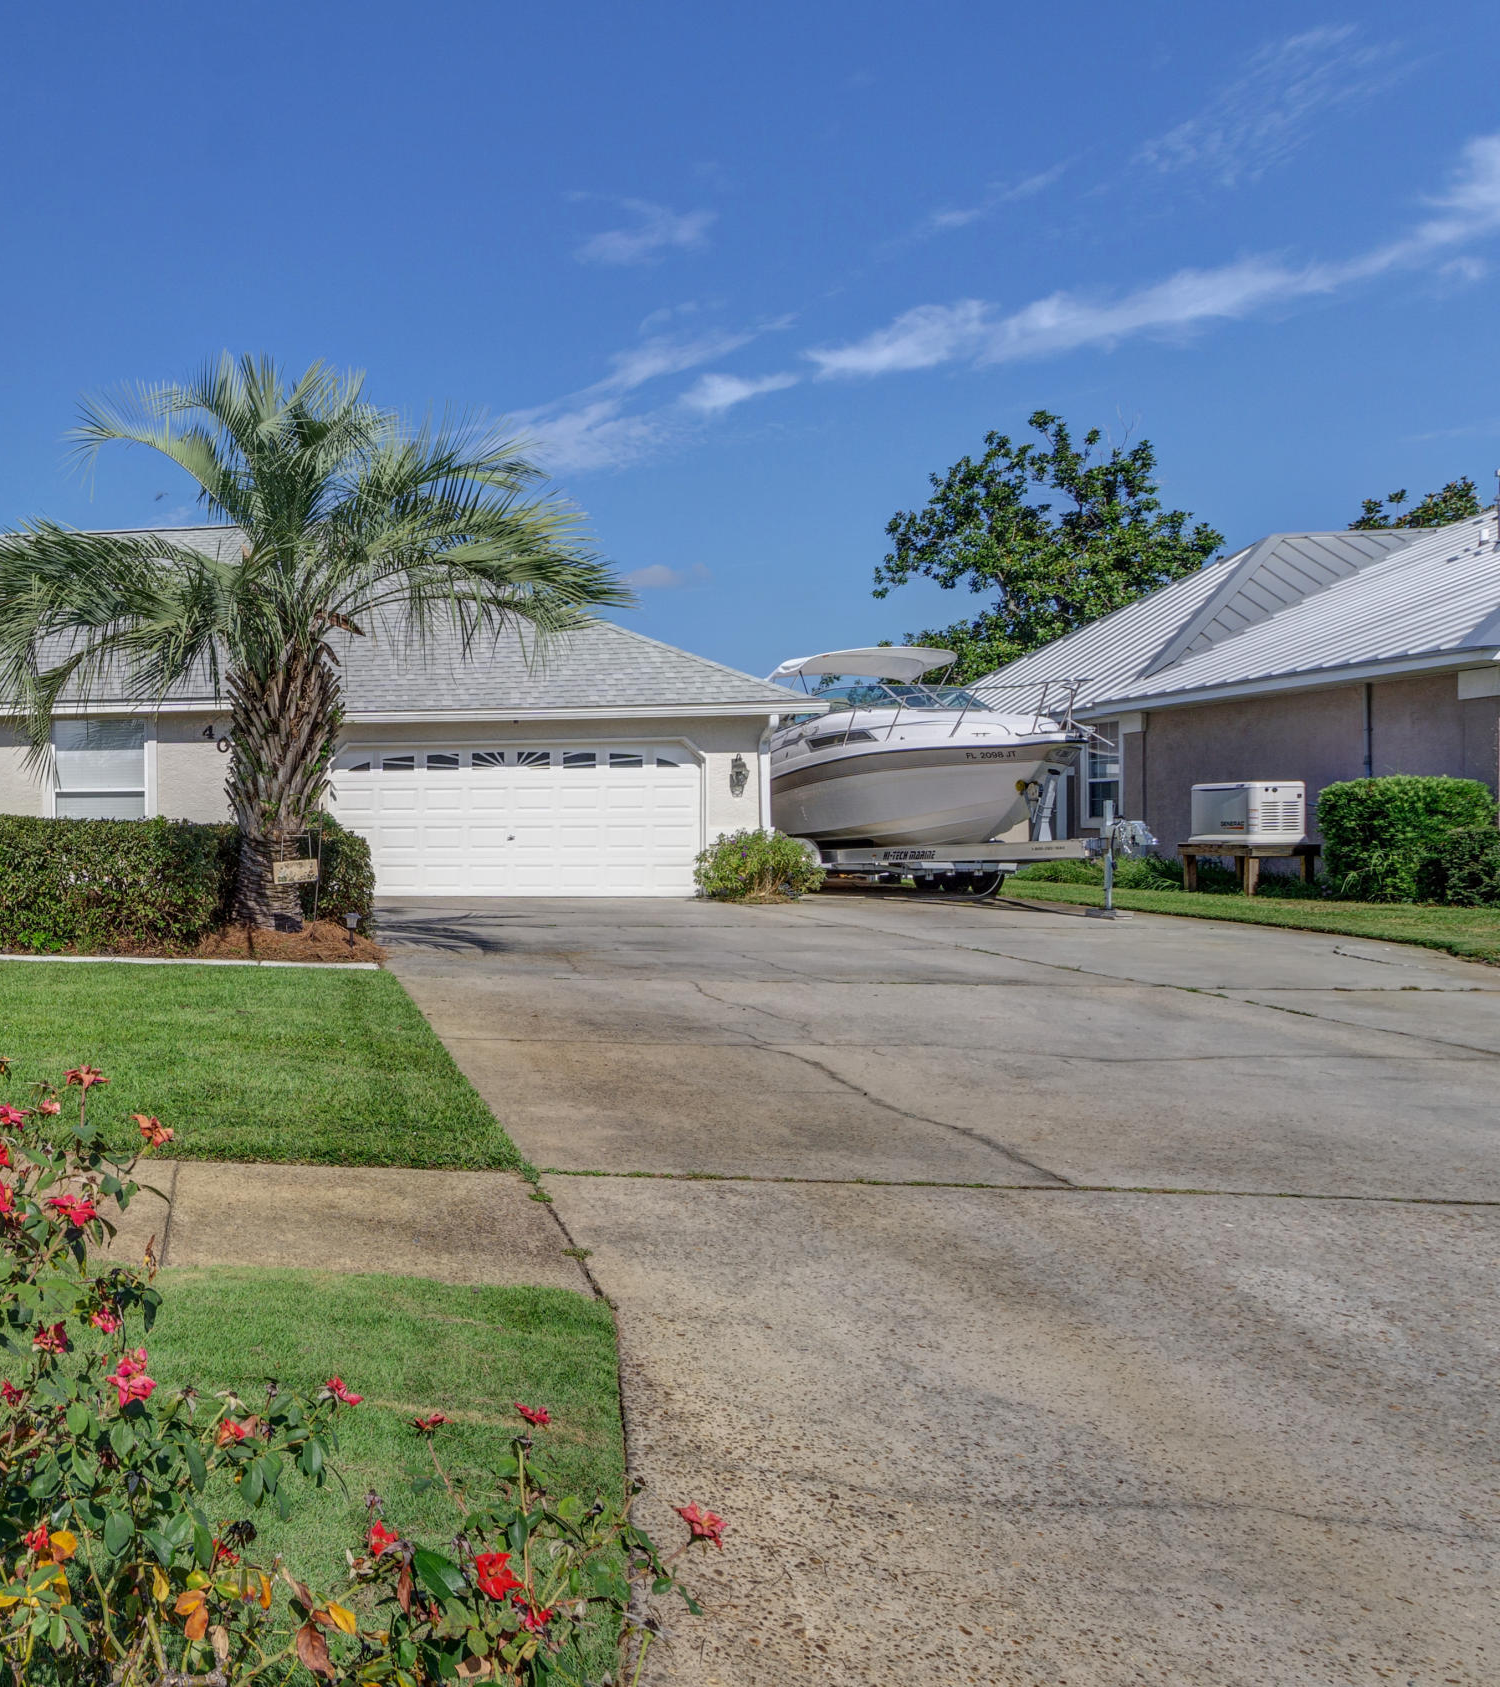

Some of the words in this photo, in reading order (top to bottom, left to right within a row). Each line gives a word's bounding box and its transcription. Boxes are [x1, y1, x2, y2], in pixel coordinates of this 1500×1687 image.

[965, 752, 977, 760] FL
[980, 751, 1004, 759] 2098
[882, 850, 909, 861] HI-TECH
